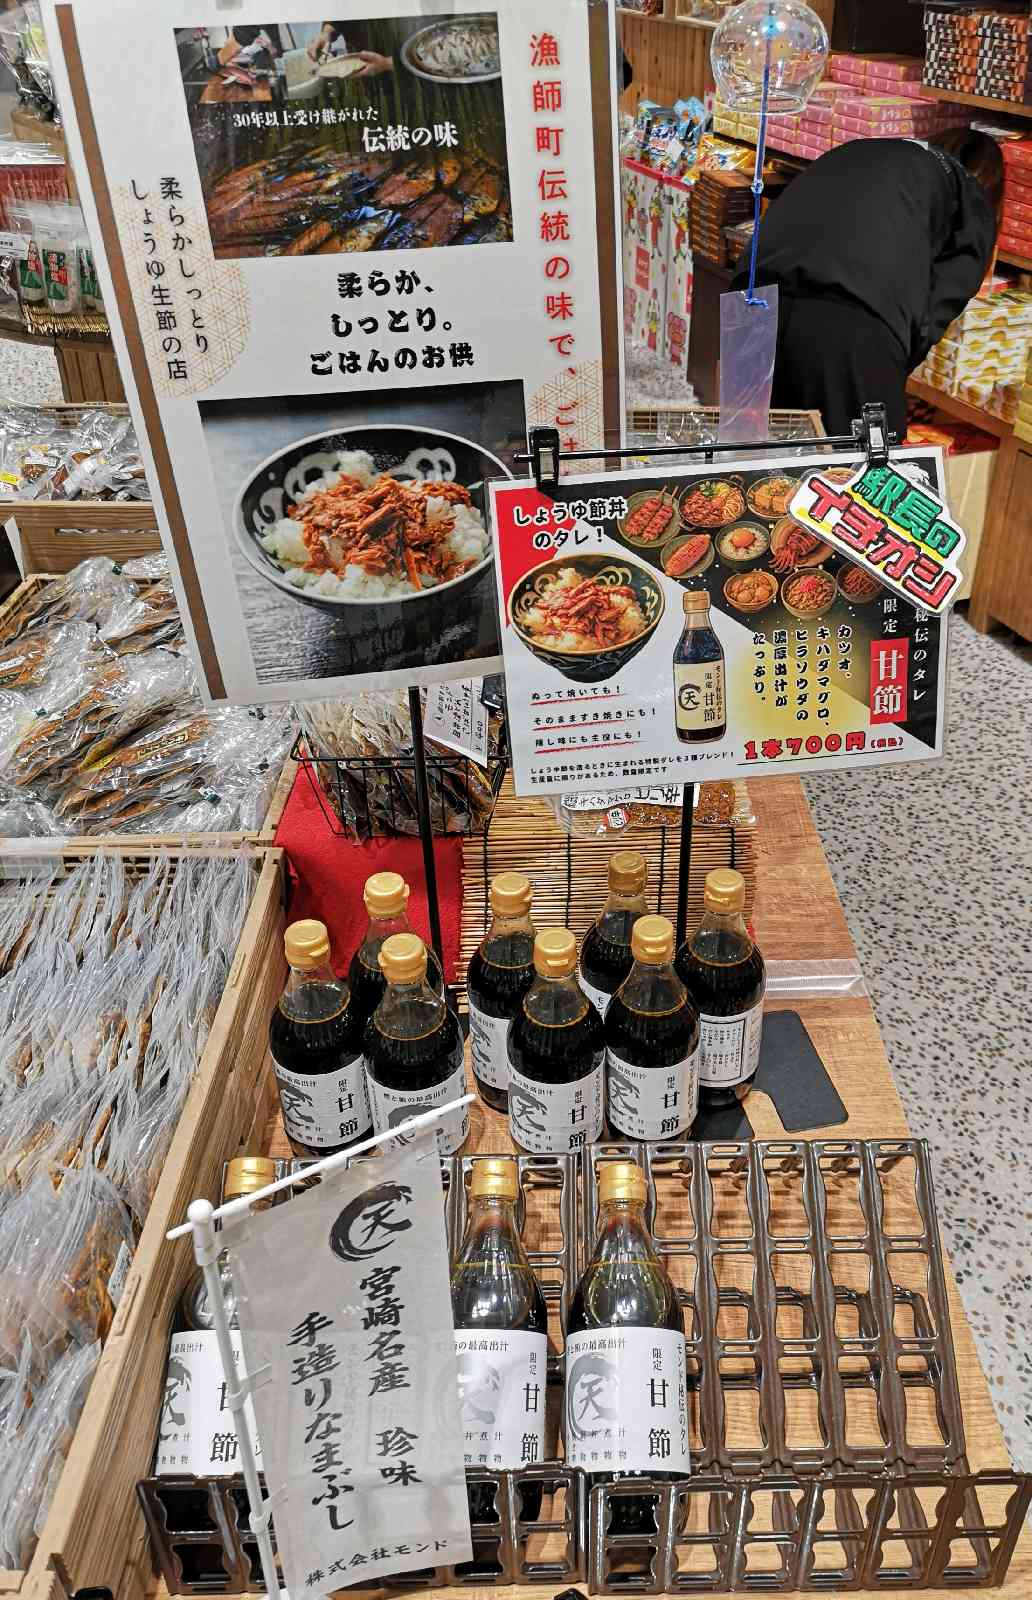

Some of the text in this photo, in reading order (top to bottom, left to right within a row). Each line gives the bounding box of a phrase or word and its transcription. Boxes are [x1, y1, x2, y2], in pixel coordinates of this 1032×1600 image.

[232, 106, 379, 128] 30年以上受け継がれた
[361, 121, 459, 152] 伝統の味
[130, 179, 188, 381] しょうゆ生節の店
[159, 176, 209, 354] 柔らかしっとり
[336, 269, 435, 299] 柔らか、
[330, 306, 453, 338] しっとり。
[310, 341, 475, 376] ごはんのお供
[514, 497, 627, 525] しょうゆ節丼
[852, 466, 961, 558] 駅長の
[534, 527, 604, 549] のタレ！
[807, 476, 957, 609] イチオシ
[882, 597, 898, 633] 限定
[795, 629, 810, 721] ヒラソウダの
[911, 605, 930, 701] 秘伝のタレ
[531, 685, 621, 700] ぬって焼いても！
[871, 649, 904, 716] 甘節
[533, 708, 657, 726] そのまますき焼きにも！
[744, 731, 866, 760] 1本700円
[335, 1093, 359, 1138] 甘節
[360, 1265, 424, 1487] 宮崎名産 珍味
[651, 1346, 664, 1372] 限定
[286, 1311, 355, 1531] 手造りなまぶし
[520, 1382, 541, 1463] 甘節
[645, 1378, 672, 1459] 甘節
[304, 1540, 448, 1587] 株式会社モンド
